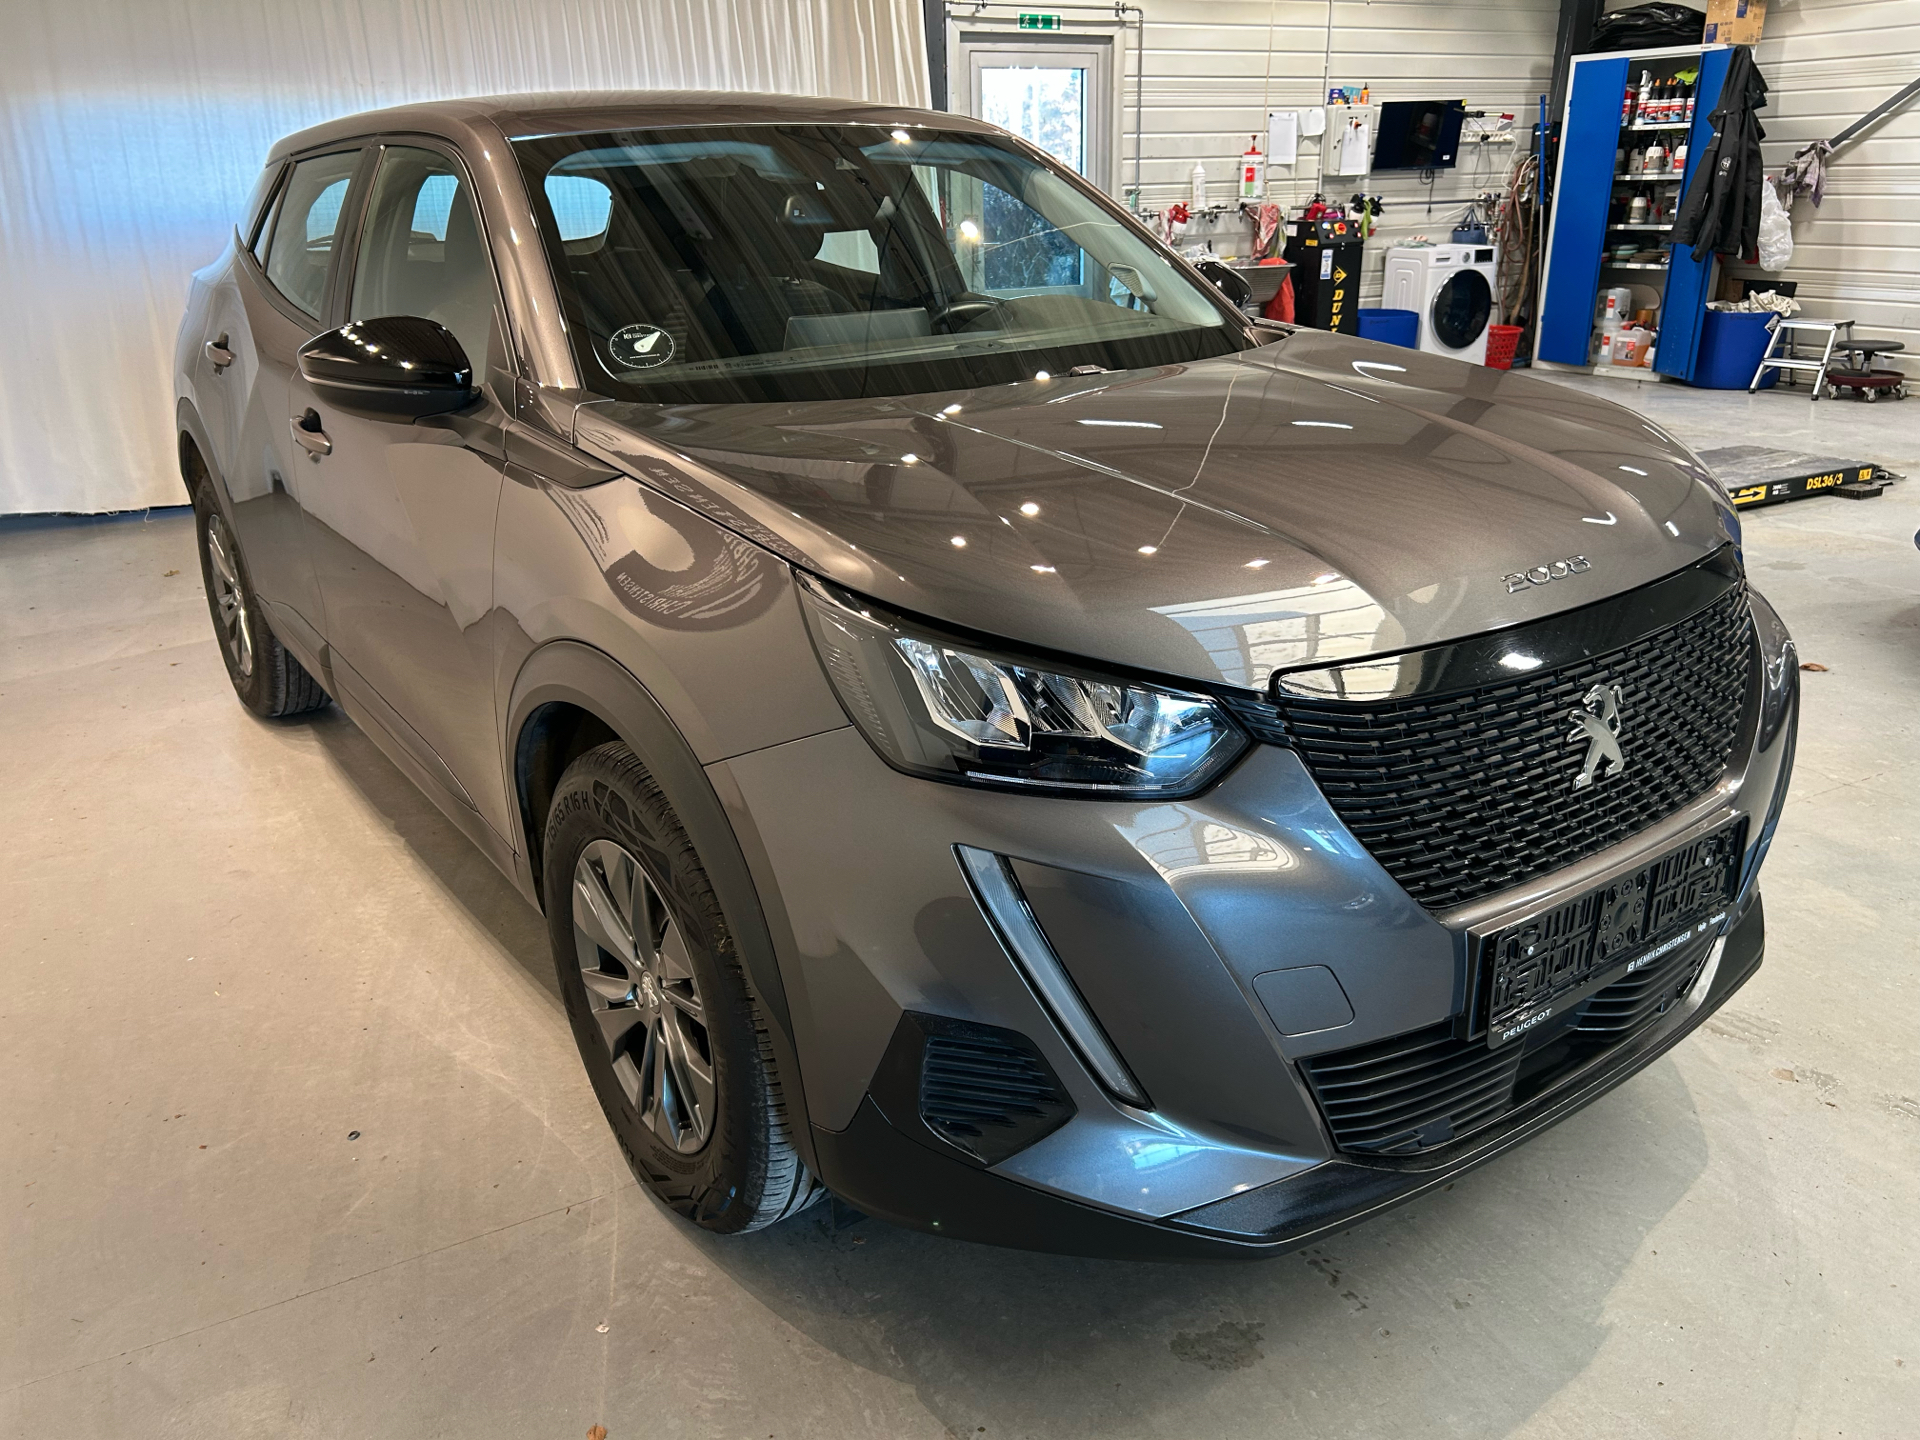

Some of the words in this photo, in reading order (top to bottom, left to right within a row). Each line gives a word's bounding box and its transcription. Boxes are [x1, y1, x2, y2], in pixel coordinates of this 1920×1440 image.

[1806, 473, 1843, 490] DSL36/3
[1500, 555, 1592, 594] 2008
[581, 791, 591, 810] H
[1635, 950, 1656, 968] HENRIK
[1655, 930, 1691, 956] CHRISTENSEN
[1502, 1008, 1552, 1040] PEUGEOT
